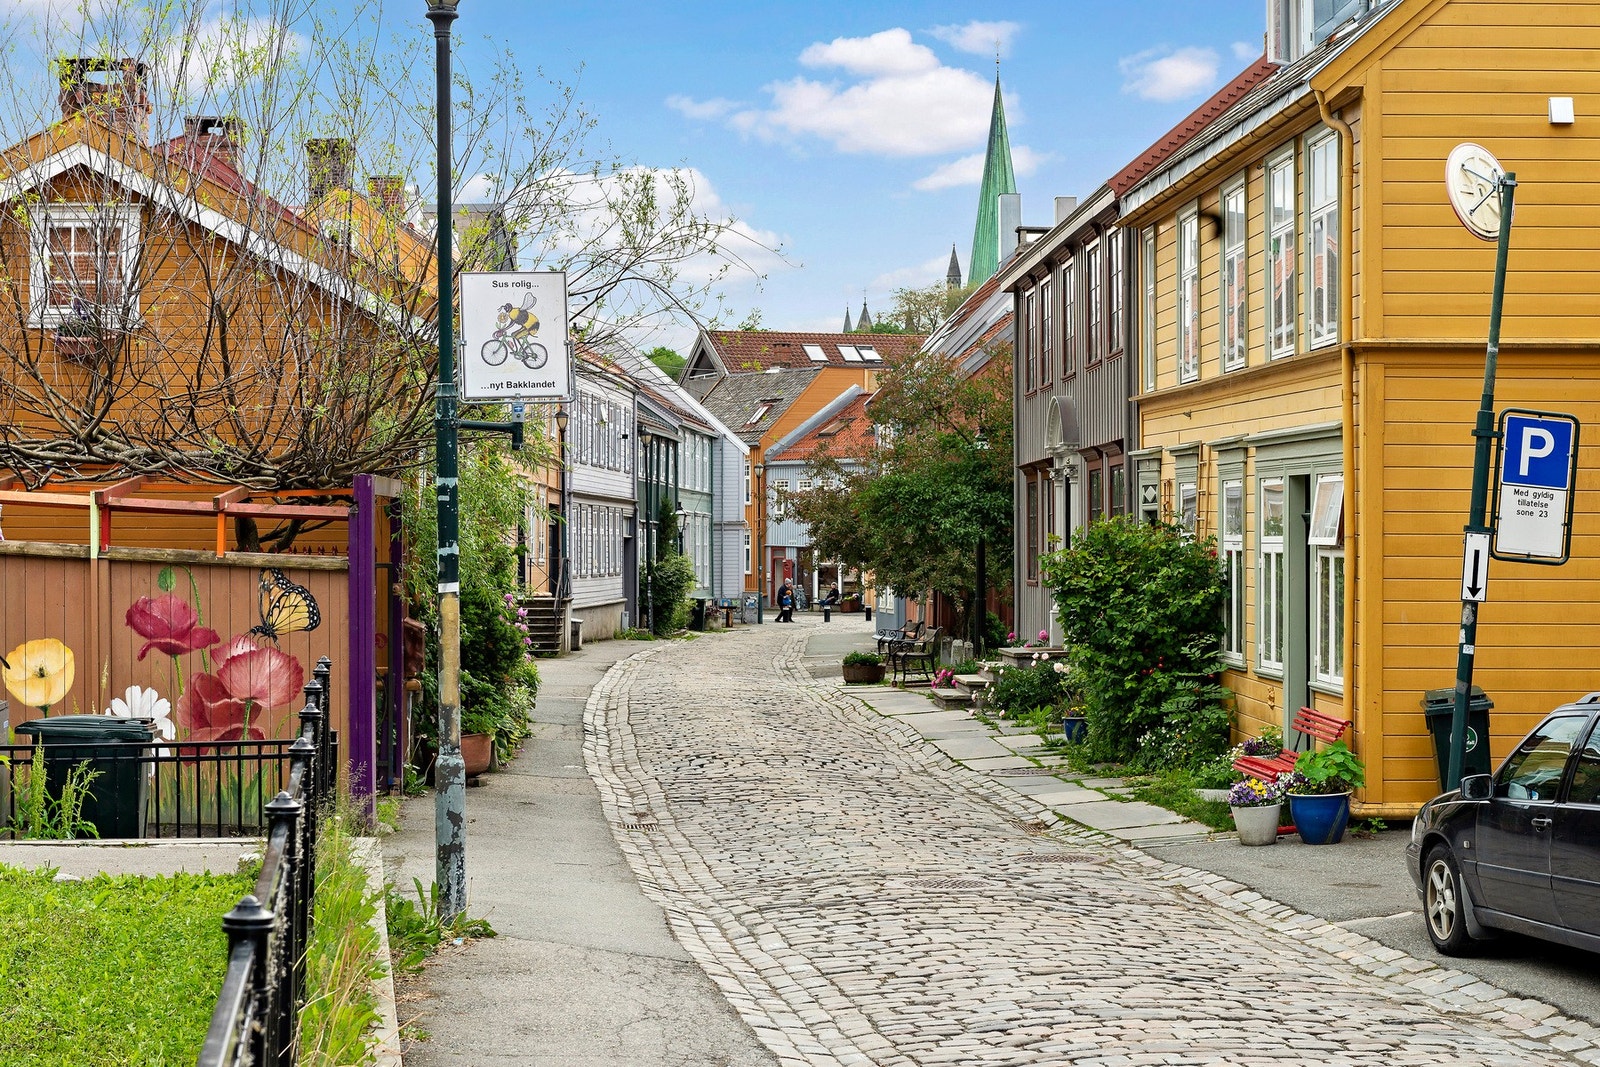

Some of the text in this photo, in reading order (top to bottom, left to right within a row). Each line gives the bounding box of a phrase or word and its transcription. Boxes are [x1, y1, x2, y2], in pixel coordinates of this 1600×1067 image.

[492, 280, 540, 290] Sus rolig...
[480, 380, 556, 390] ...nyt Bakklandet
[1519, 426, 1555, 476] P
[1513, 488, 1554, 501] Med gyldig
[1517, 499, 1549, 509] tillatelse
[1516, 509, 1549, 518] sone 23
